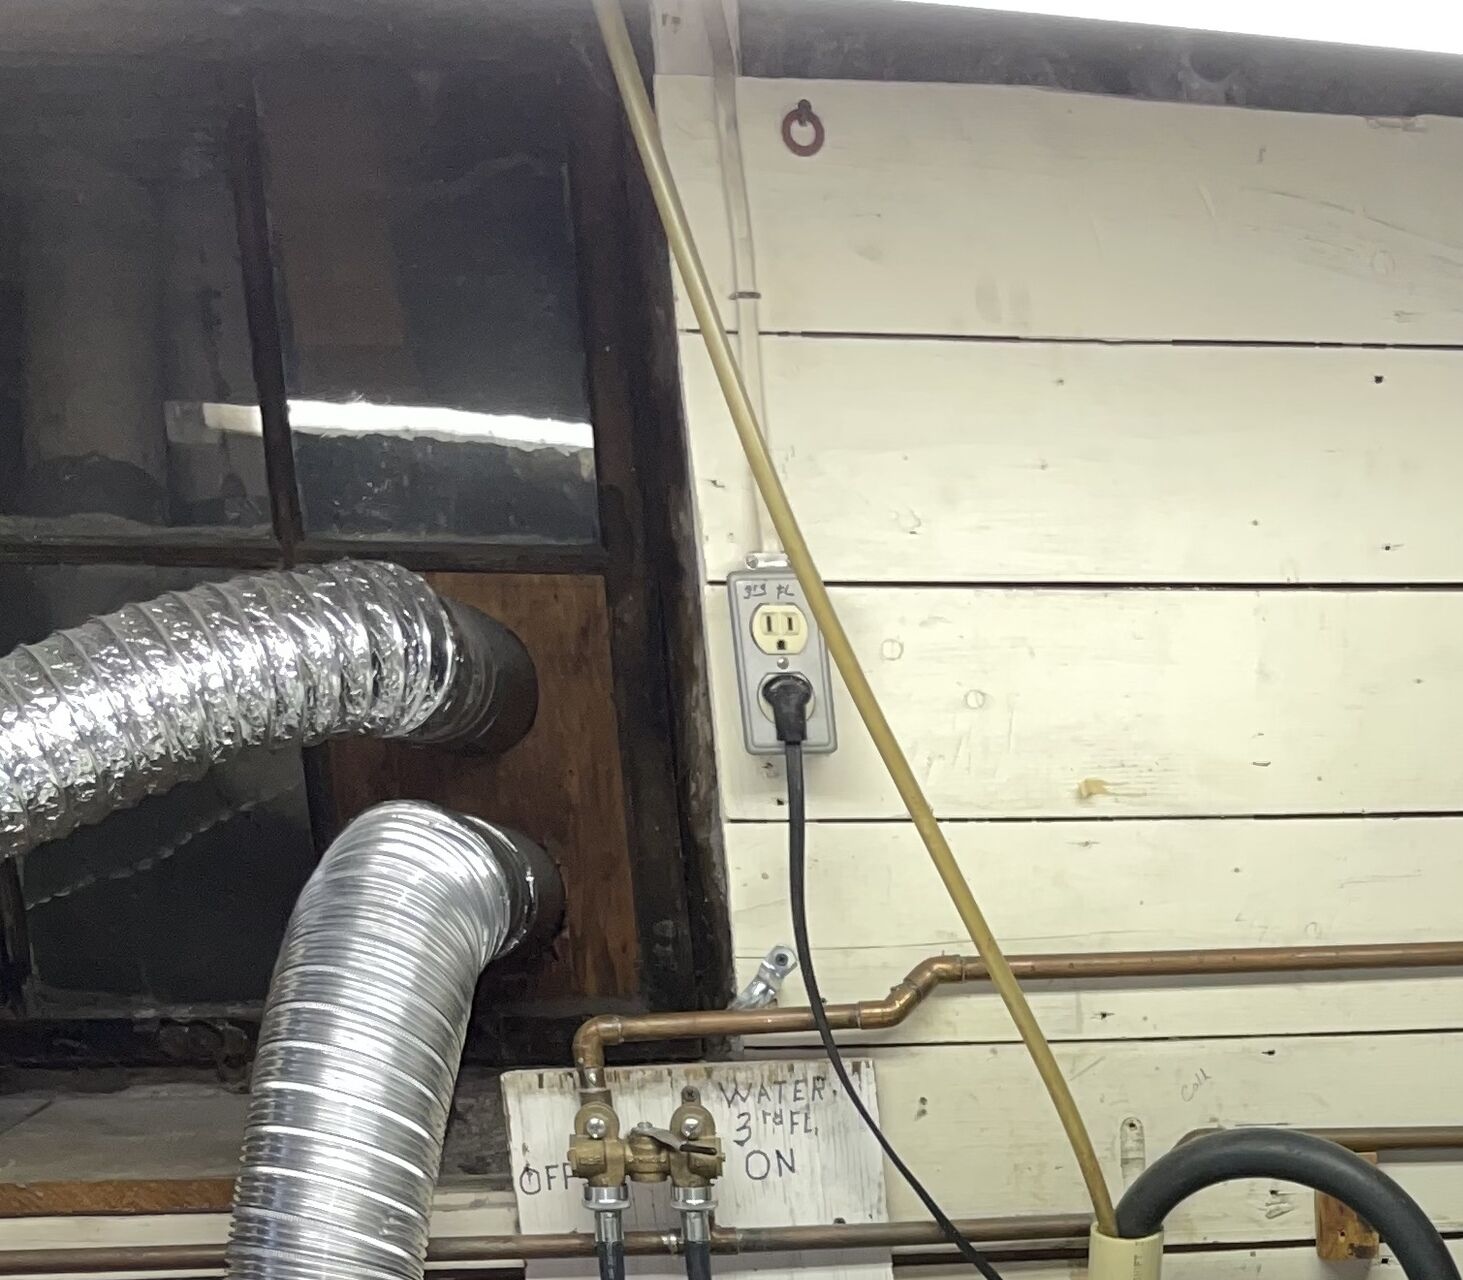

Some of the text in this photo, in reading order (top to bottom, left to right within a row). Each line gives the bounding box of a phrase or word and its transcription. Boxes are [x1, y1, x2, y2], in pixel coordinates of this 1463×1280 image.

[733, 1109, 784, 1147] 3rd
[519, 1162, 574, 1195] OFF
[745, 1148, 796, 1181] ON
